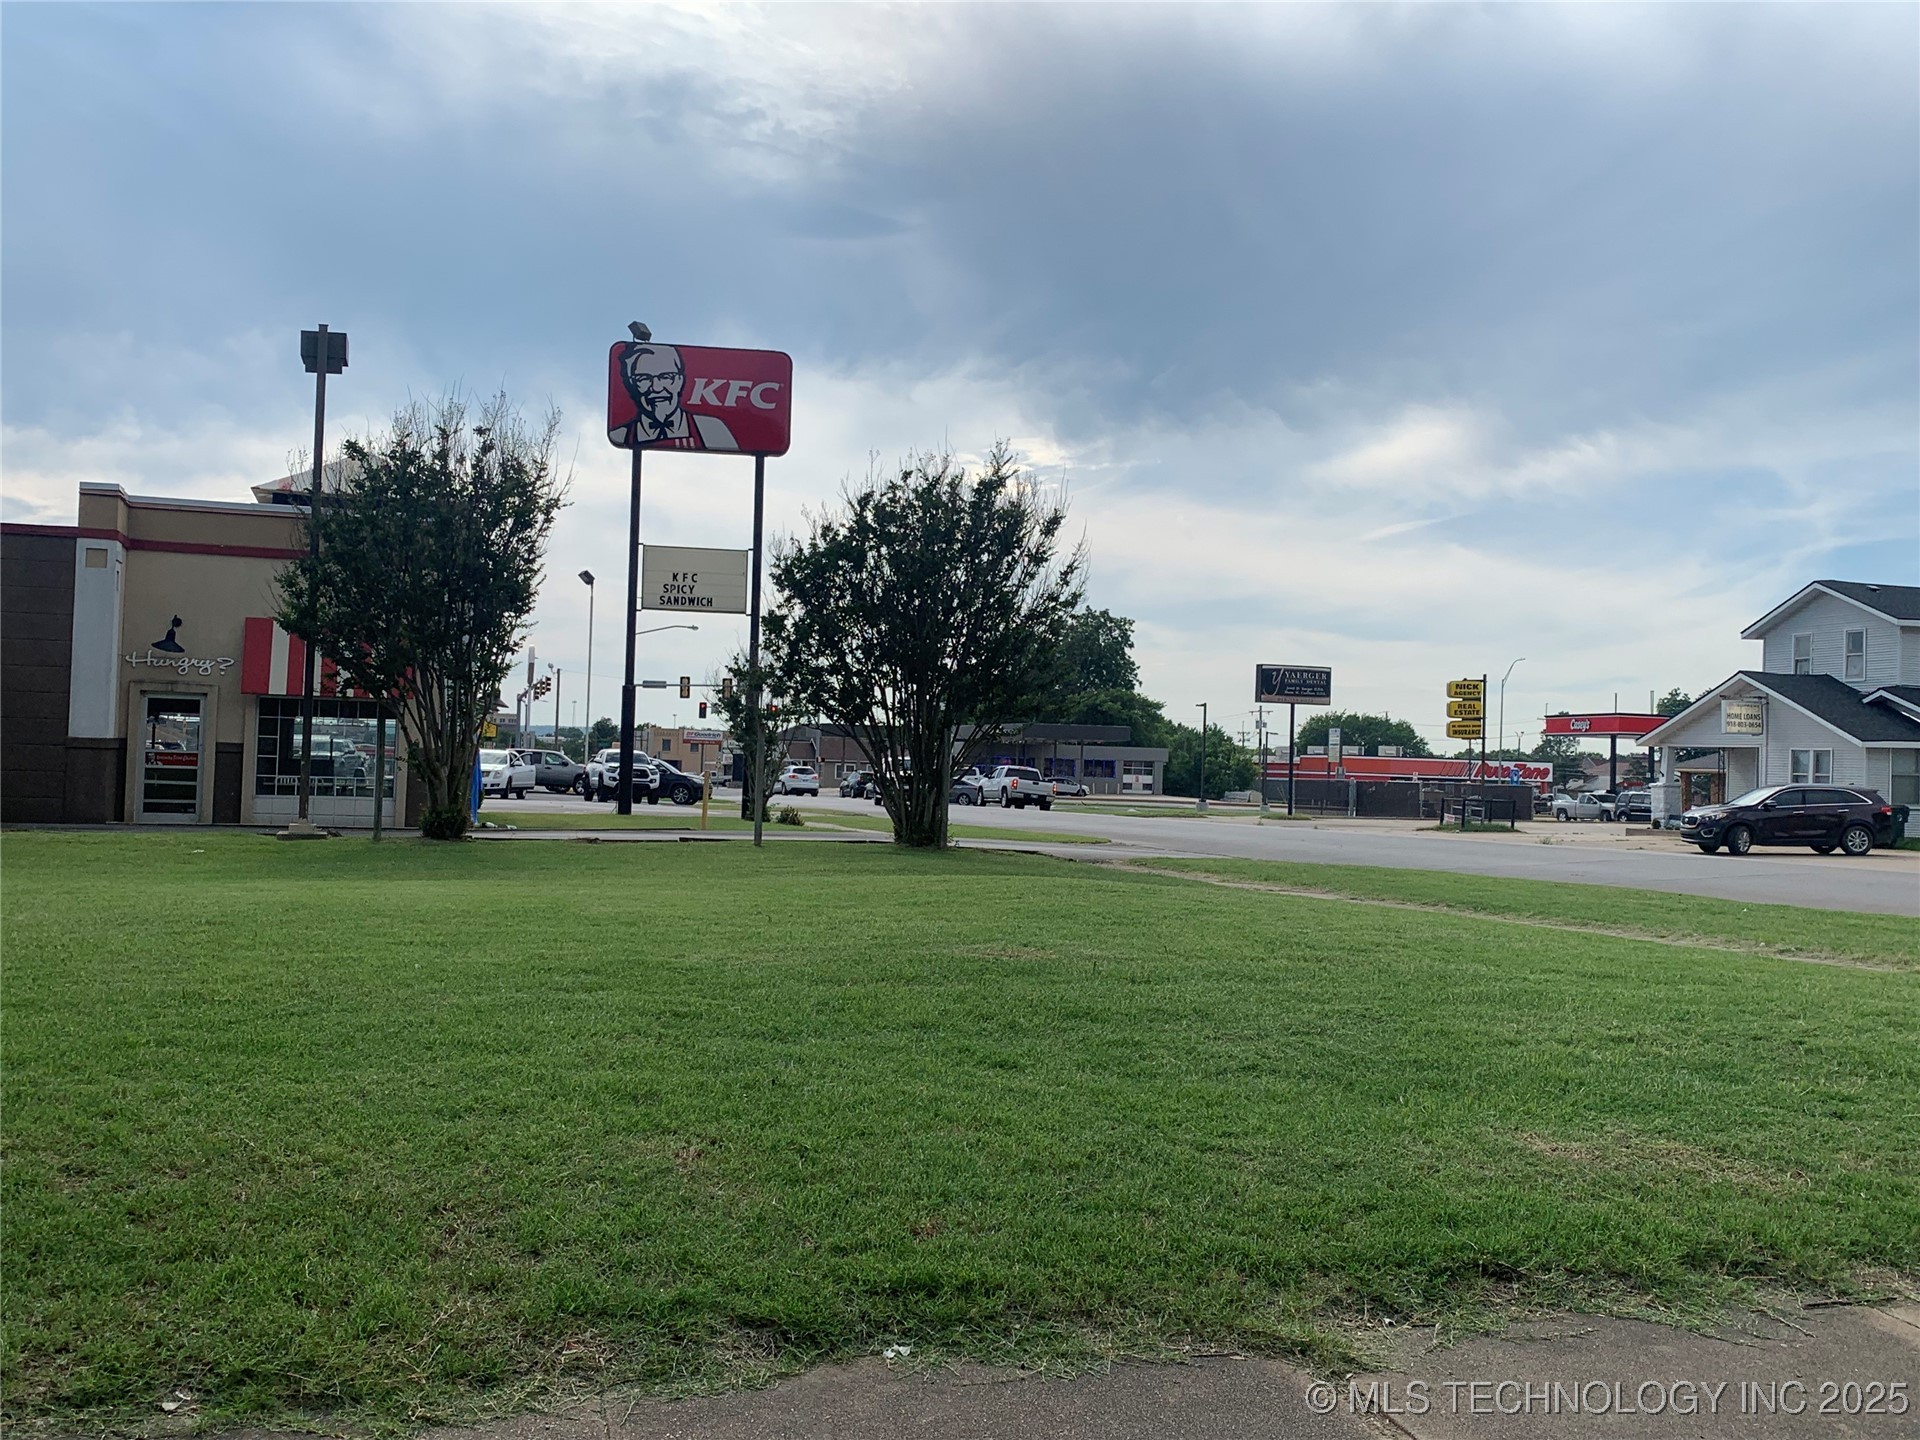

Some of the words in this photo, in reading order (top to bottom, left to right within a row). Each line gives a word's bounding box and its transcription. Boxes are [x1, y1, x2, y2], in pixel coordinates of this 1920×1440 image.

[687, 378, 780, 410] KFC
[663, 584, 695, 594] SPICY
[659, 595, 713, 607] SANDWICH
[126, 650, 235, 675] Hungry?
[1284, 671, 1327, 680] YAERGER
[1726, 712, 1743, 720] HOME
[1743, 713, 1761, 721] LOANS
[1570, 719, 1591, 732] Casey's
